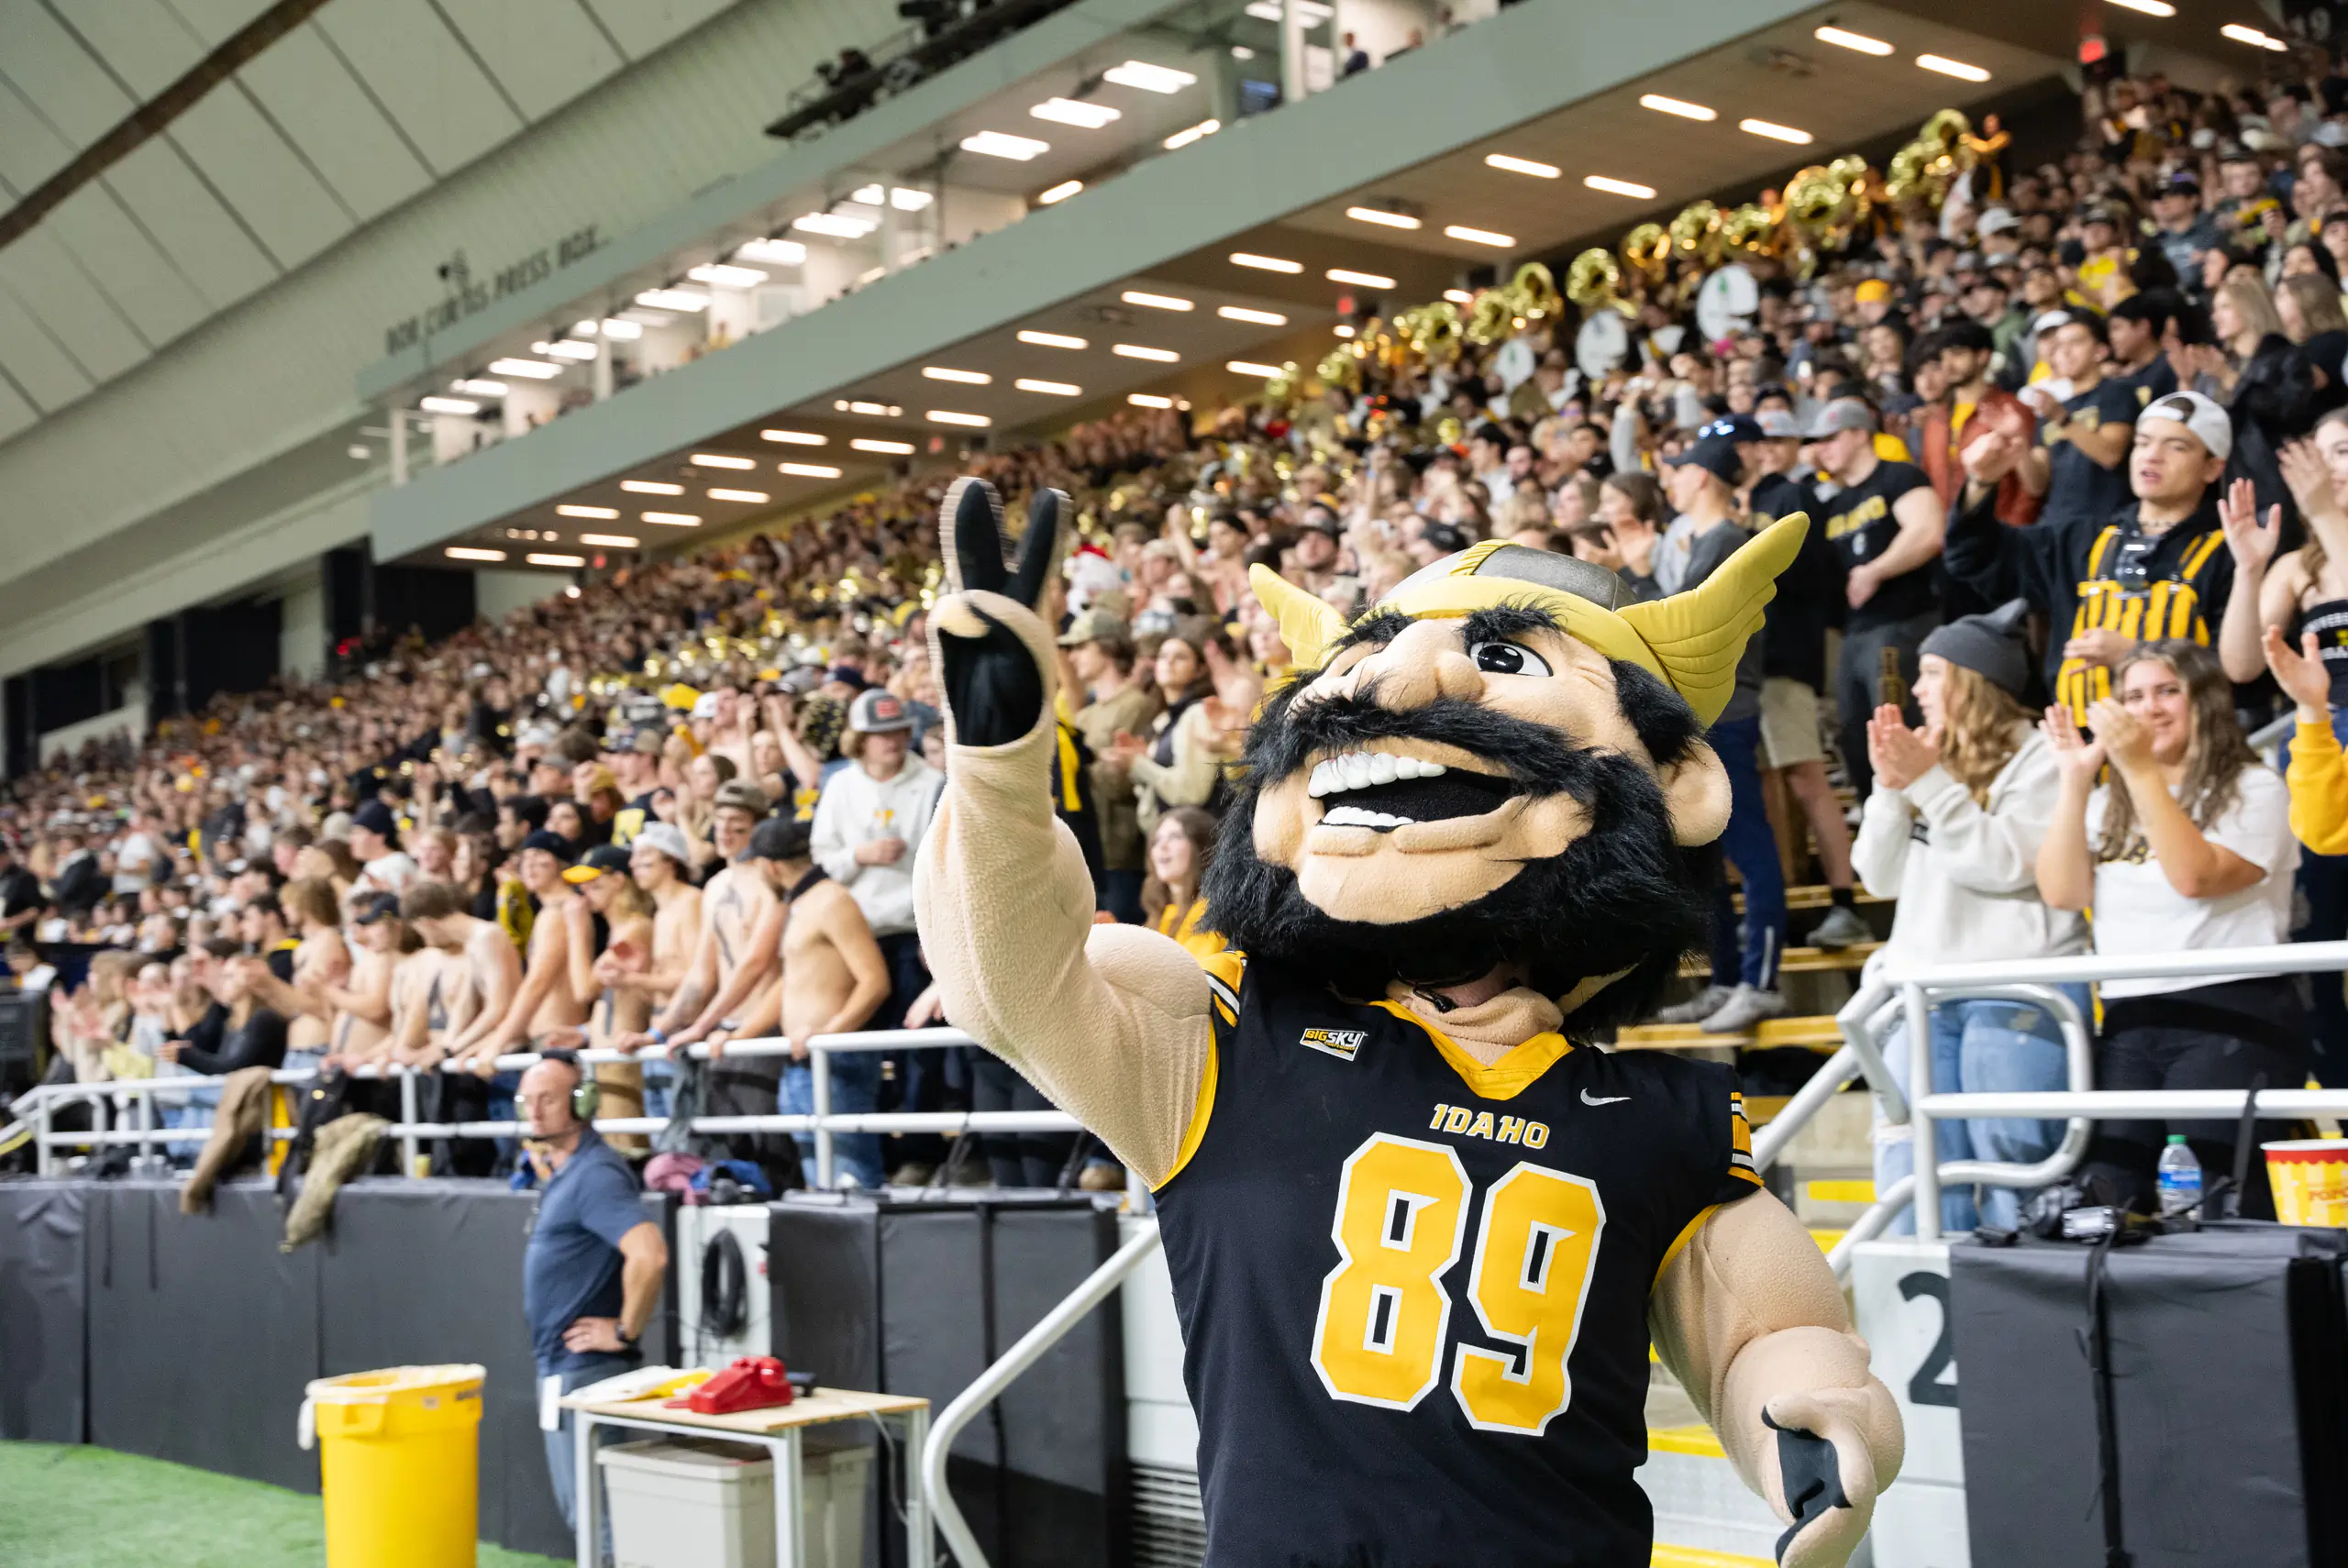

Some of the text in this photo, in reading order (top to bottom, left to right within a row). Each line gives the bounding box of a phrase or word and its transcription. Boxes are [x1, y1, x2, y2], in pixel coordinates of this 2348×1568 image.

[493, 248, 550, 299] PRESS
[1429, 1103, 1550, 1149] IDAHO
[1310, 1131, 1607, 1437] 89
[1898, 1271, 1958, 1408] 2
